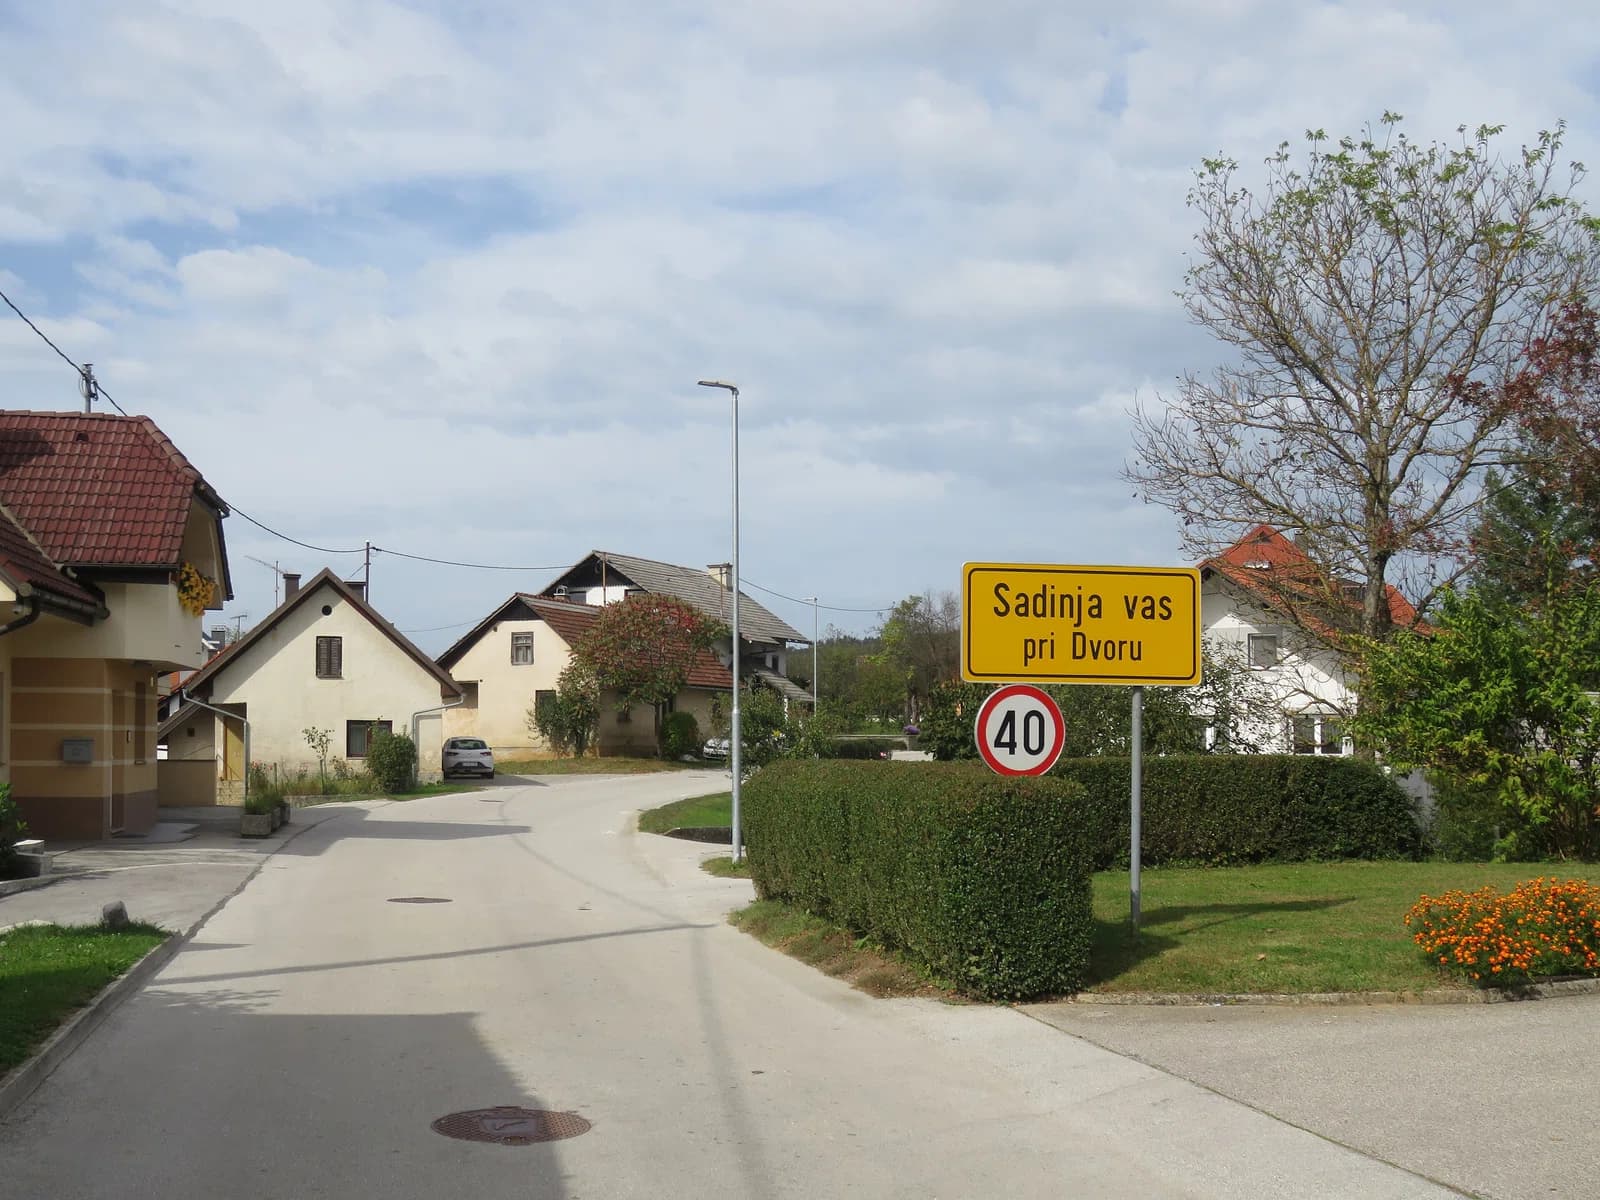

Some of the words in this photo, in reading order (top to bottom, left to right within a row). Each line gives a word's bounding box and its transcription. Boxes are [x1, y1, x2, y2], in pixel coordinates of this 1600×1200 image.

[993, 582, 1103, 627] Sadinja
[1124, 595, 1173, 621] vas
[1024, 632, 1055, 667] pri
[1072, 631, 1142, 661] Dvoru
[993, 710, 1046, 756] 40
